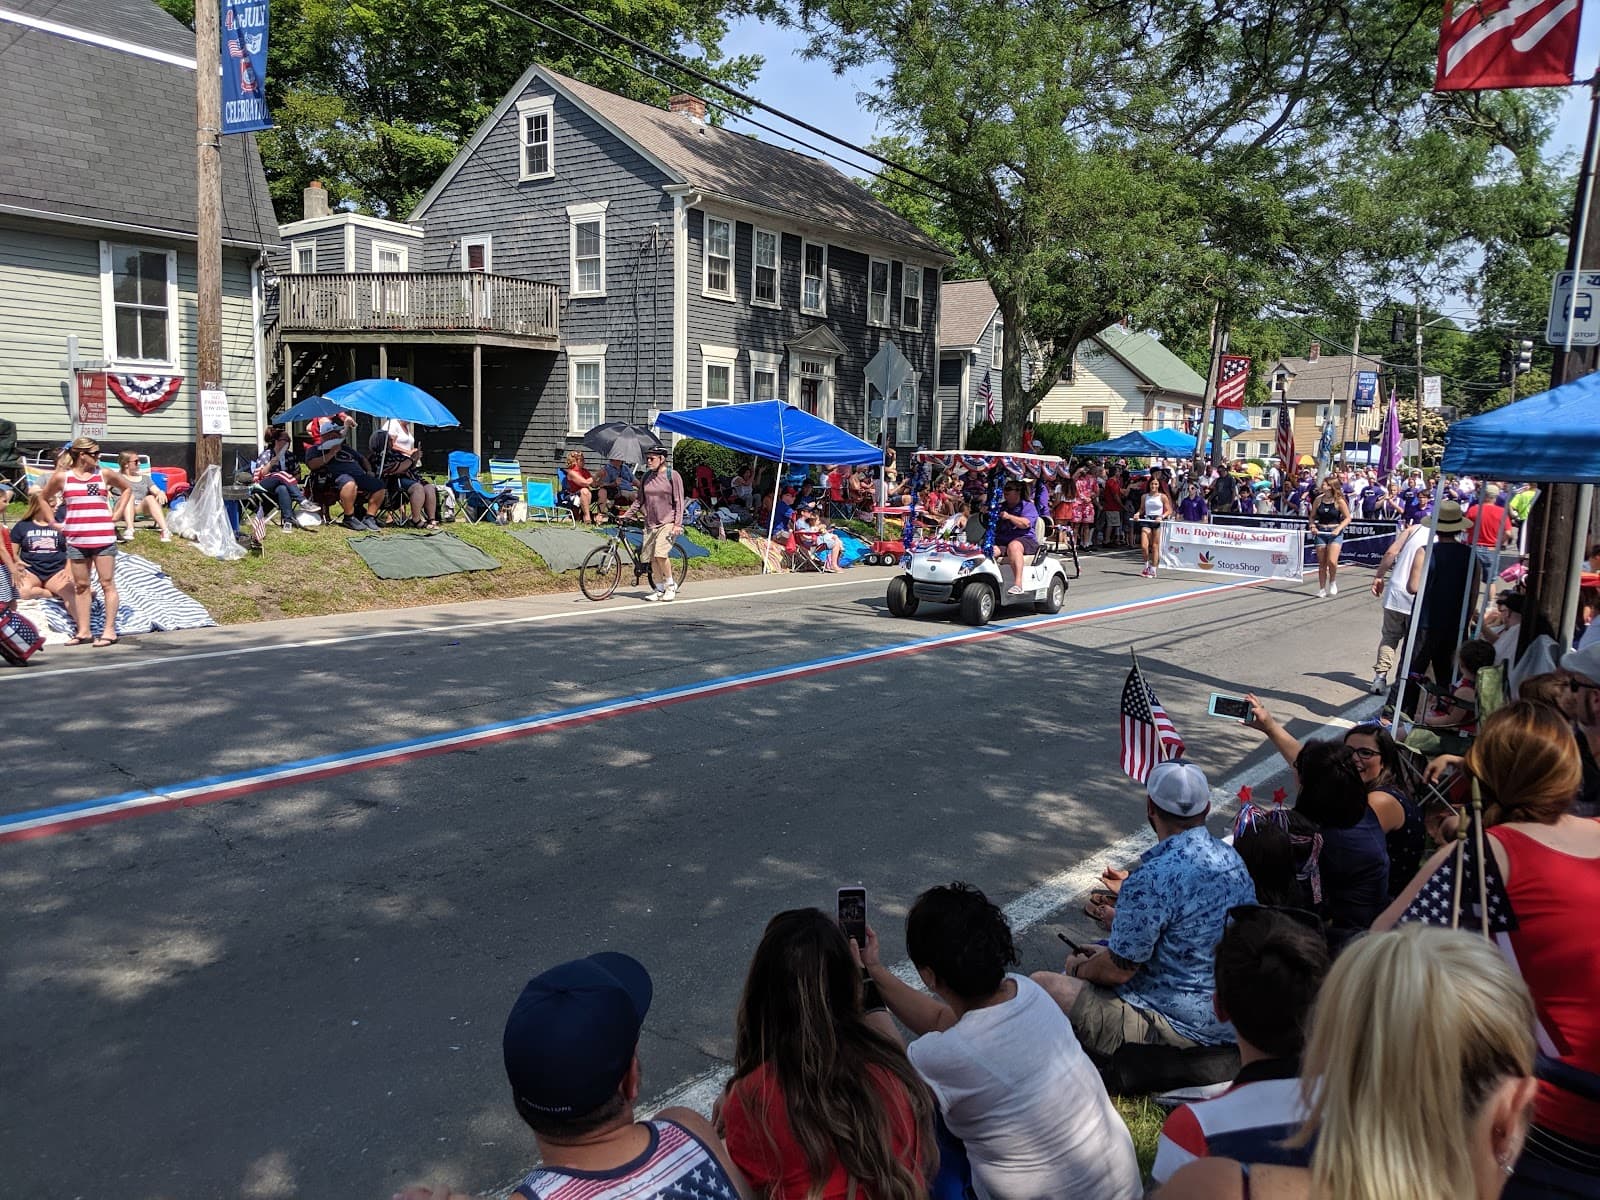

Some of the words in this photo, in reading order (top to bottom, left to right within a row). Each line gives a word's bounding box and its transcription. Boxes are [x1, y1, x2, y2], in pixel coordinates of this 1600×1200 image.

[241, 5, 266, 28] JULY
[81, 427, 91, 437] FOR
[91, 427, 104, 438] RENT
[27, 529, 41, 537] OLD
[41, 529, 58, 537] NAVY
[1175, 526, 1191, 536] Mt.
[1193, 528, 1220, 539] Hope
[1222, 530, 1248, 541] High
[1251, 533, 1287, 544] School
[1343, 526, 1376, 535] CHOOL
